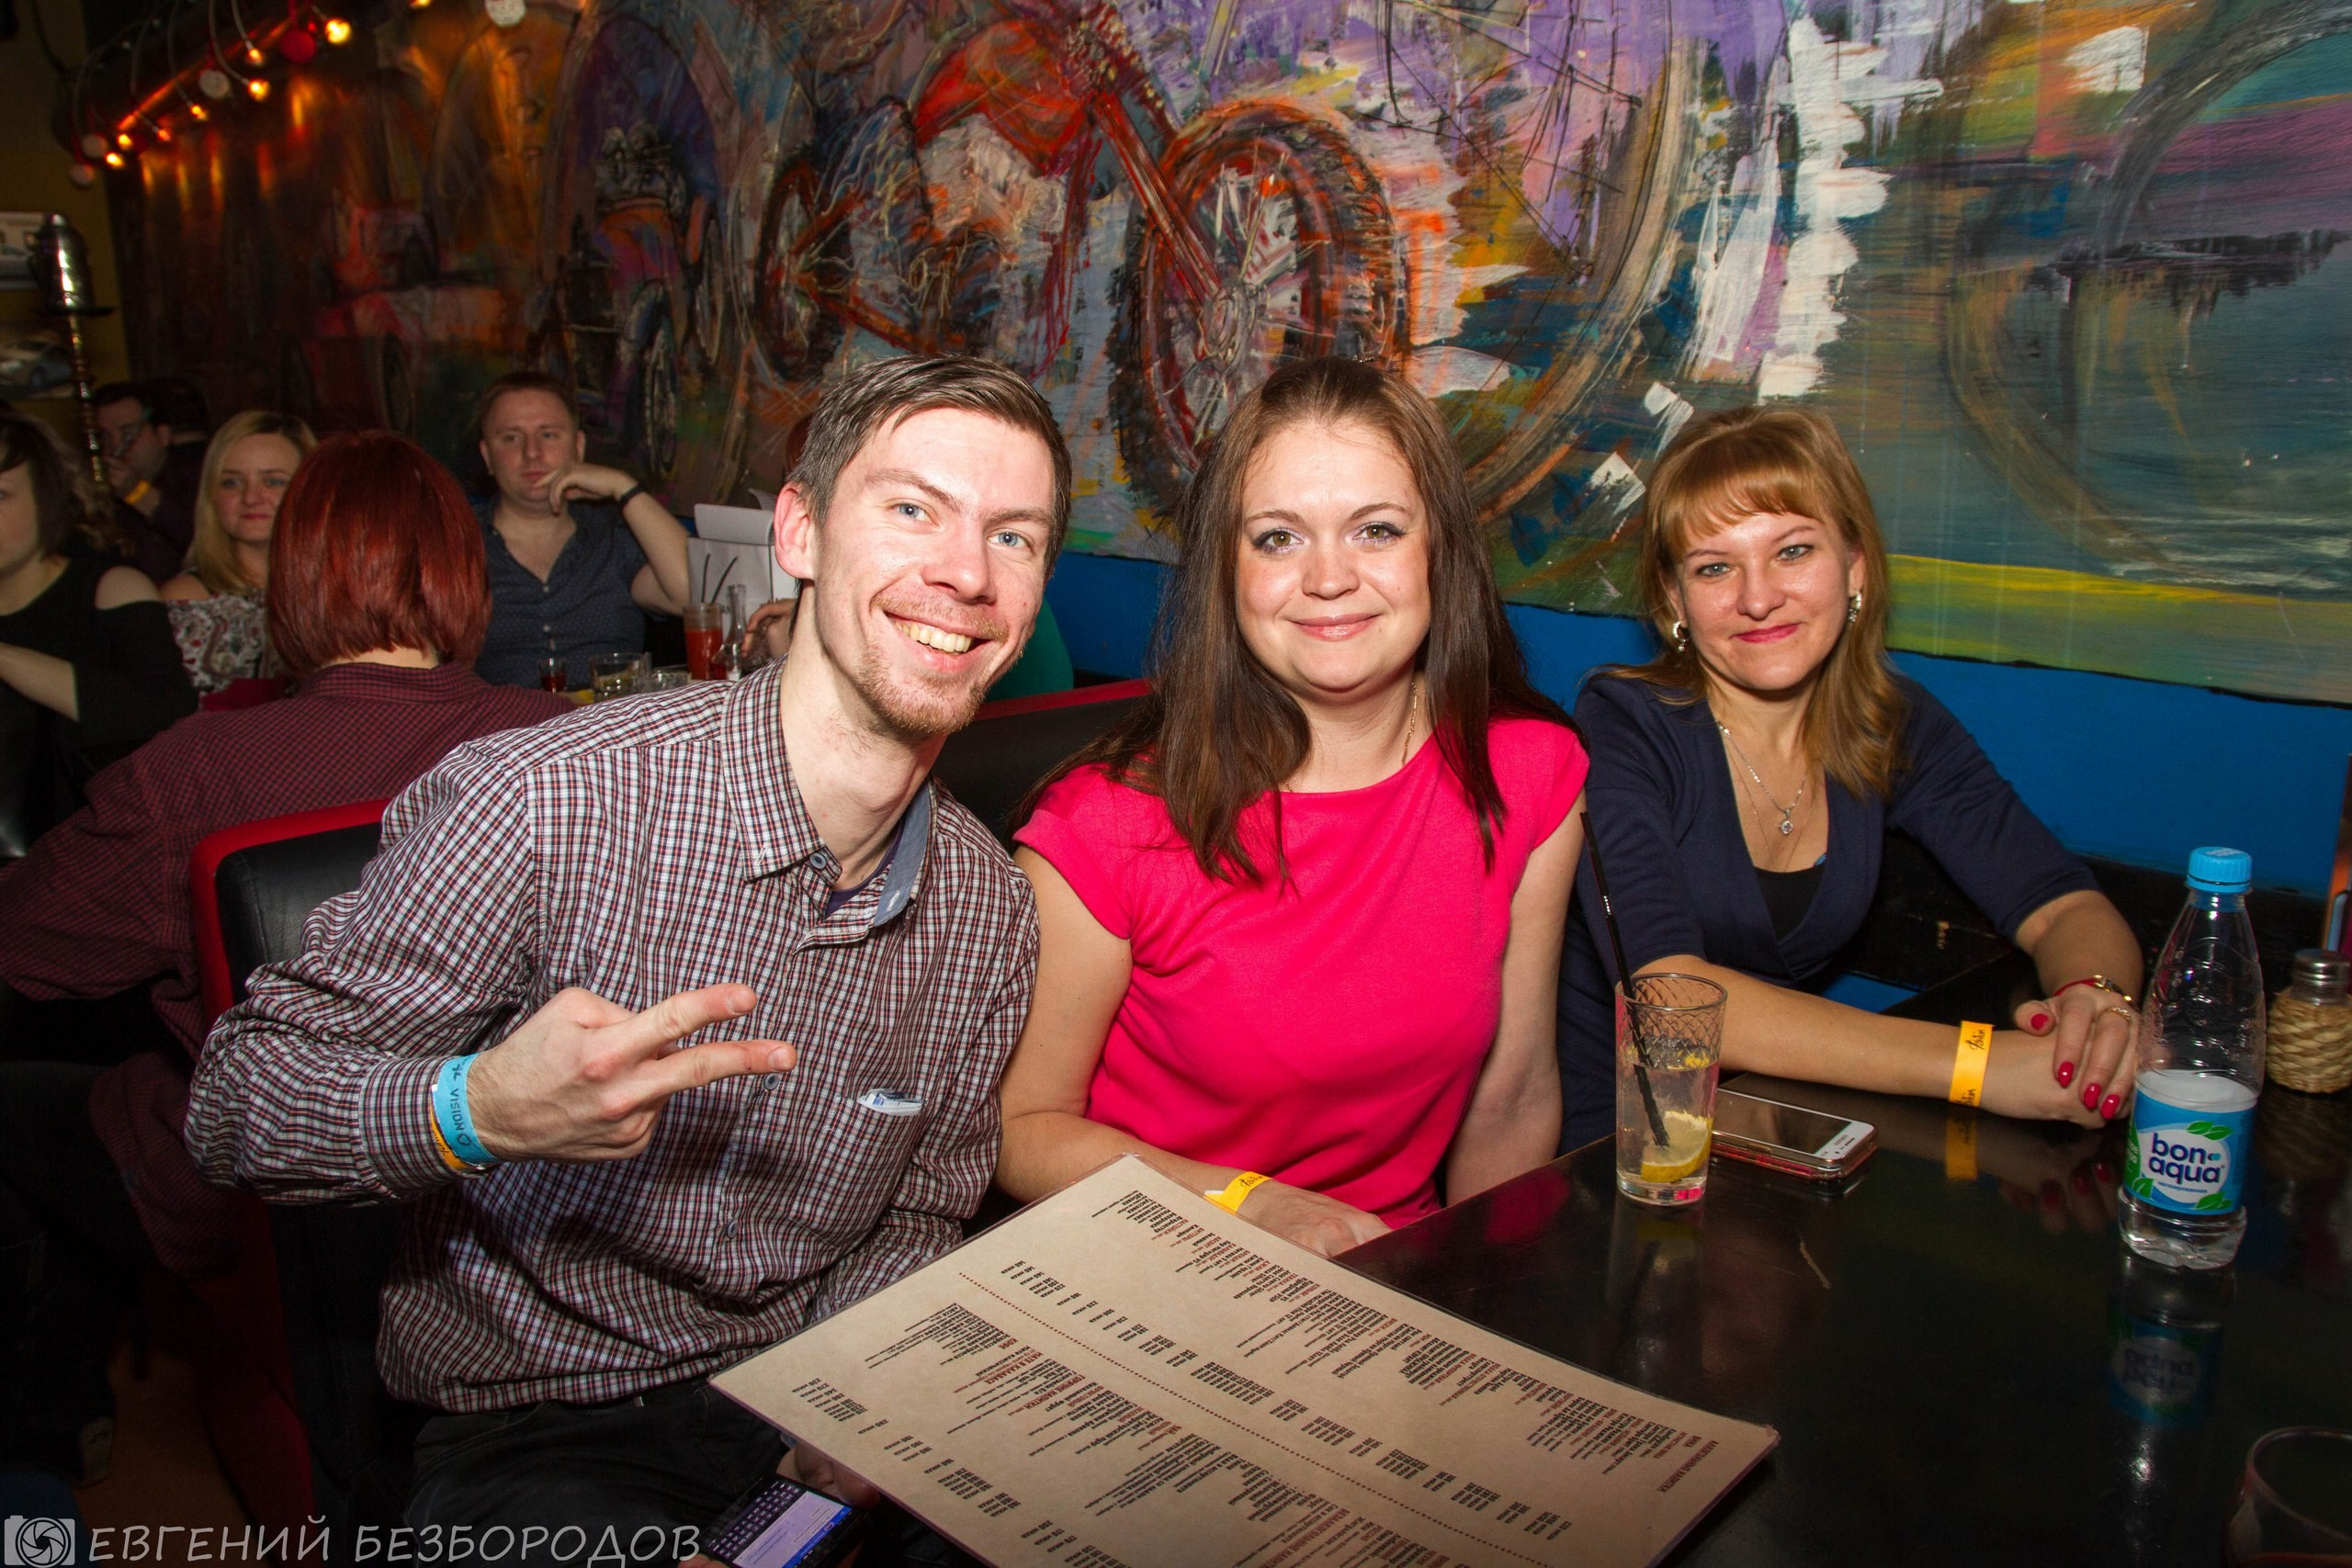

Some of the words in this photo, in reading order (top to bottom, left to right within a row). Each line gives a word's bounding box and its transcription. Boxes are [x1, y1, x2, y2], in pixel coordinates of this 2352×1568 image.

[449, 1088, 465, 1132] VISION
[2152, 1133, 2206, 1164] bon
[2149, 1156, 2220, 1184] aqua
[1256, 1274, 1274, 1285] Cuervo
[1262, 1277, 1281, 1288] Cuervo
[1278, 1269, 1290, 1278] Jose
[999, 1337, 1017, 1349] КОФЕ
[1023, 1351, 1043, 1363] МАТЕ
[984, 1364, 1020, 1384] КАЛАБАСЕ
[1055, 1374, 1085, 1392] ГОРЯЧИЕ
[1023, 1390, 1057, 1408] НАПИТКИ
